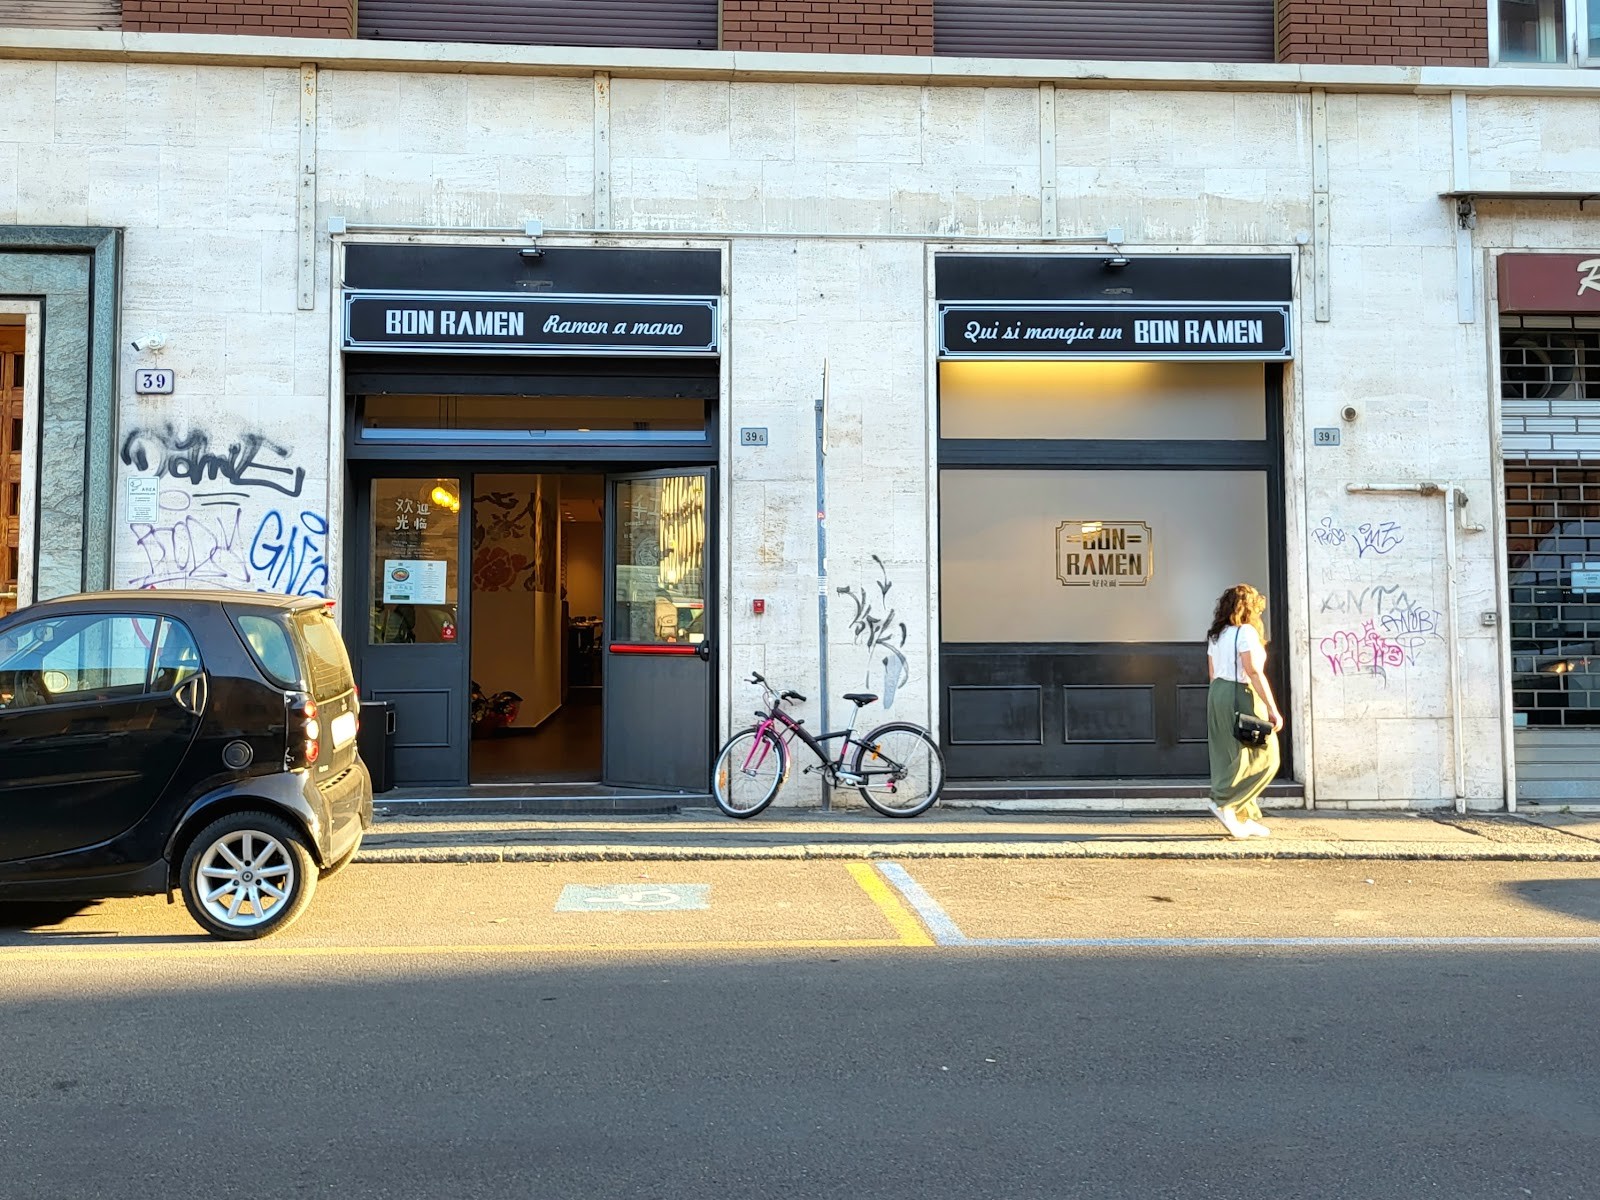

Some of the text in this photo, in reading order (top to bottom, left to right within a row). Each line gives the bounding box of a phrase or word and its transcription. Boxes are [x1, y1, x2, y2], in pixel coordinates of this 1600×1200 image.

[385, 309, 525, 336] BON RAMEN
[542, 314, 684, 336] Ramen a mano
[964, 320, 1123, 345] Qui si mangia un
[1134, 319, 1263, 344] BON RAMEN
[143, 374, 166, 389] 39
[745, 431, 758, 442] 39
[1318, 431, 1331, 442] 39
[394, 497, 432, 516] 欢迎
[394, 514, 428, 531] 光临
[1066, 553, 1142, 576] RAMEN
